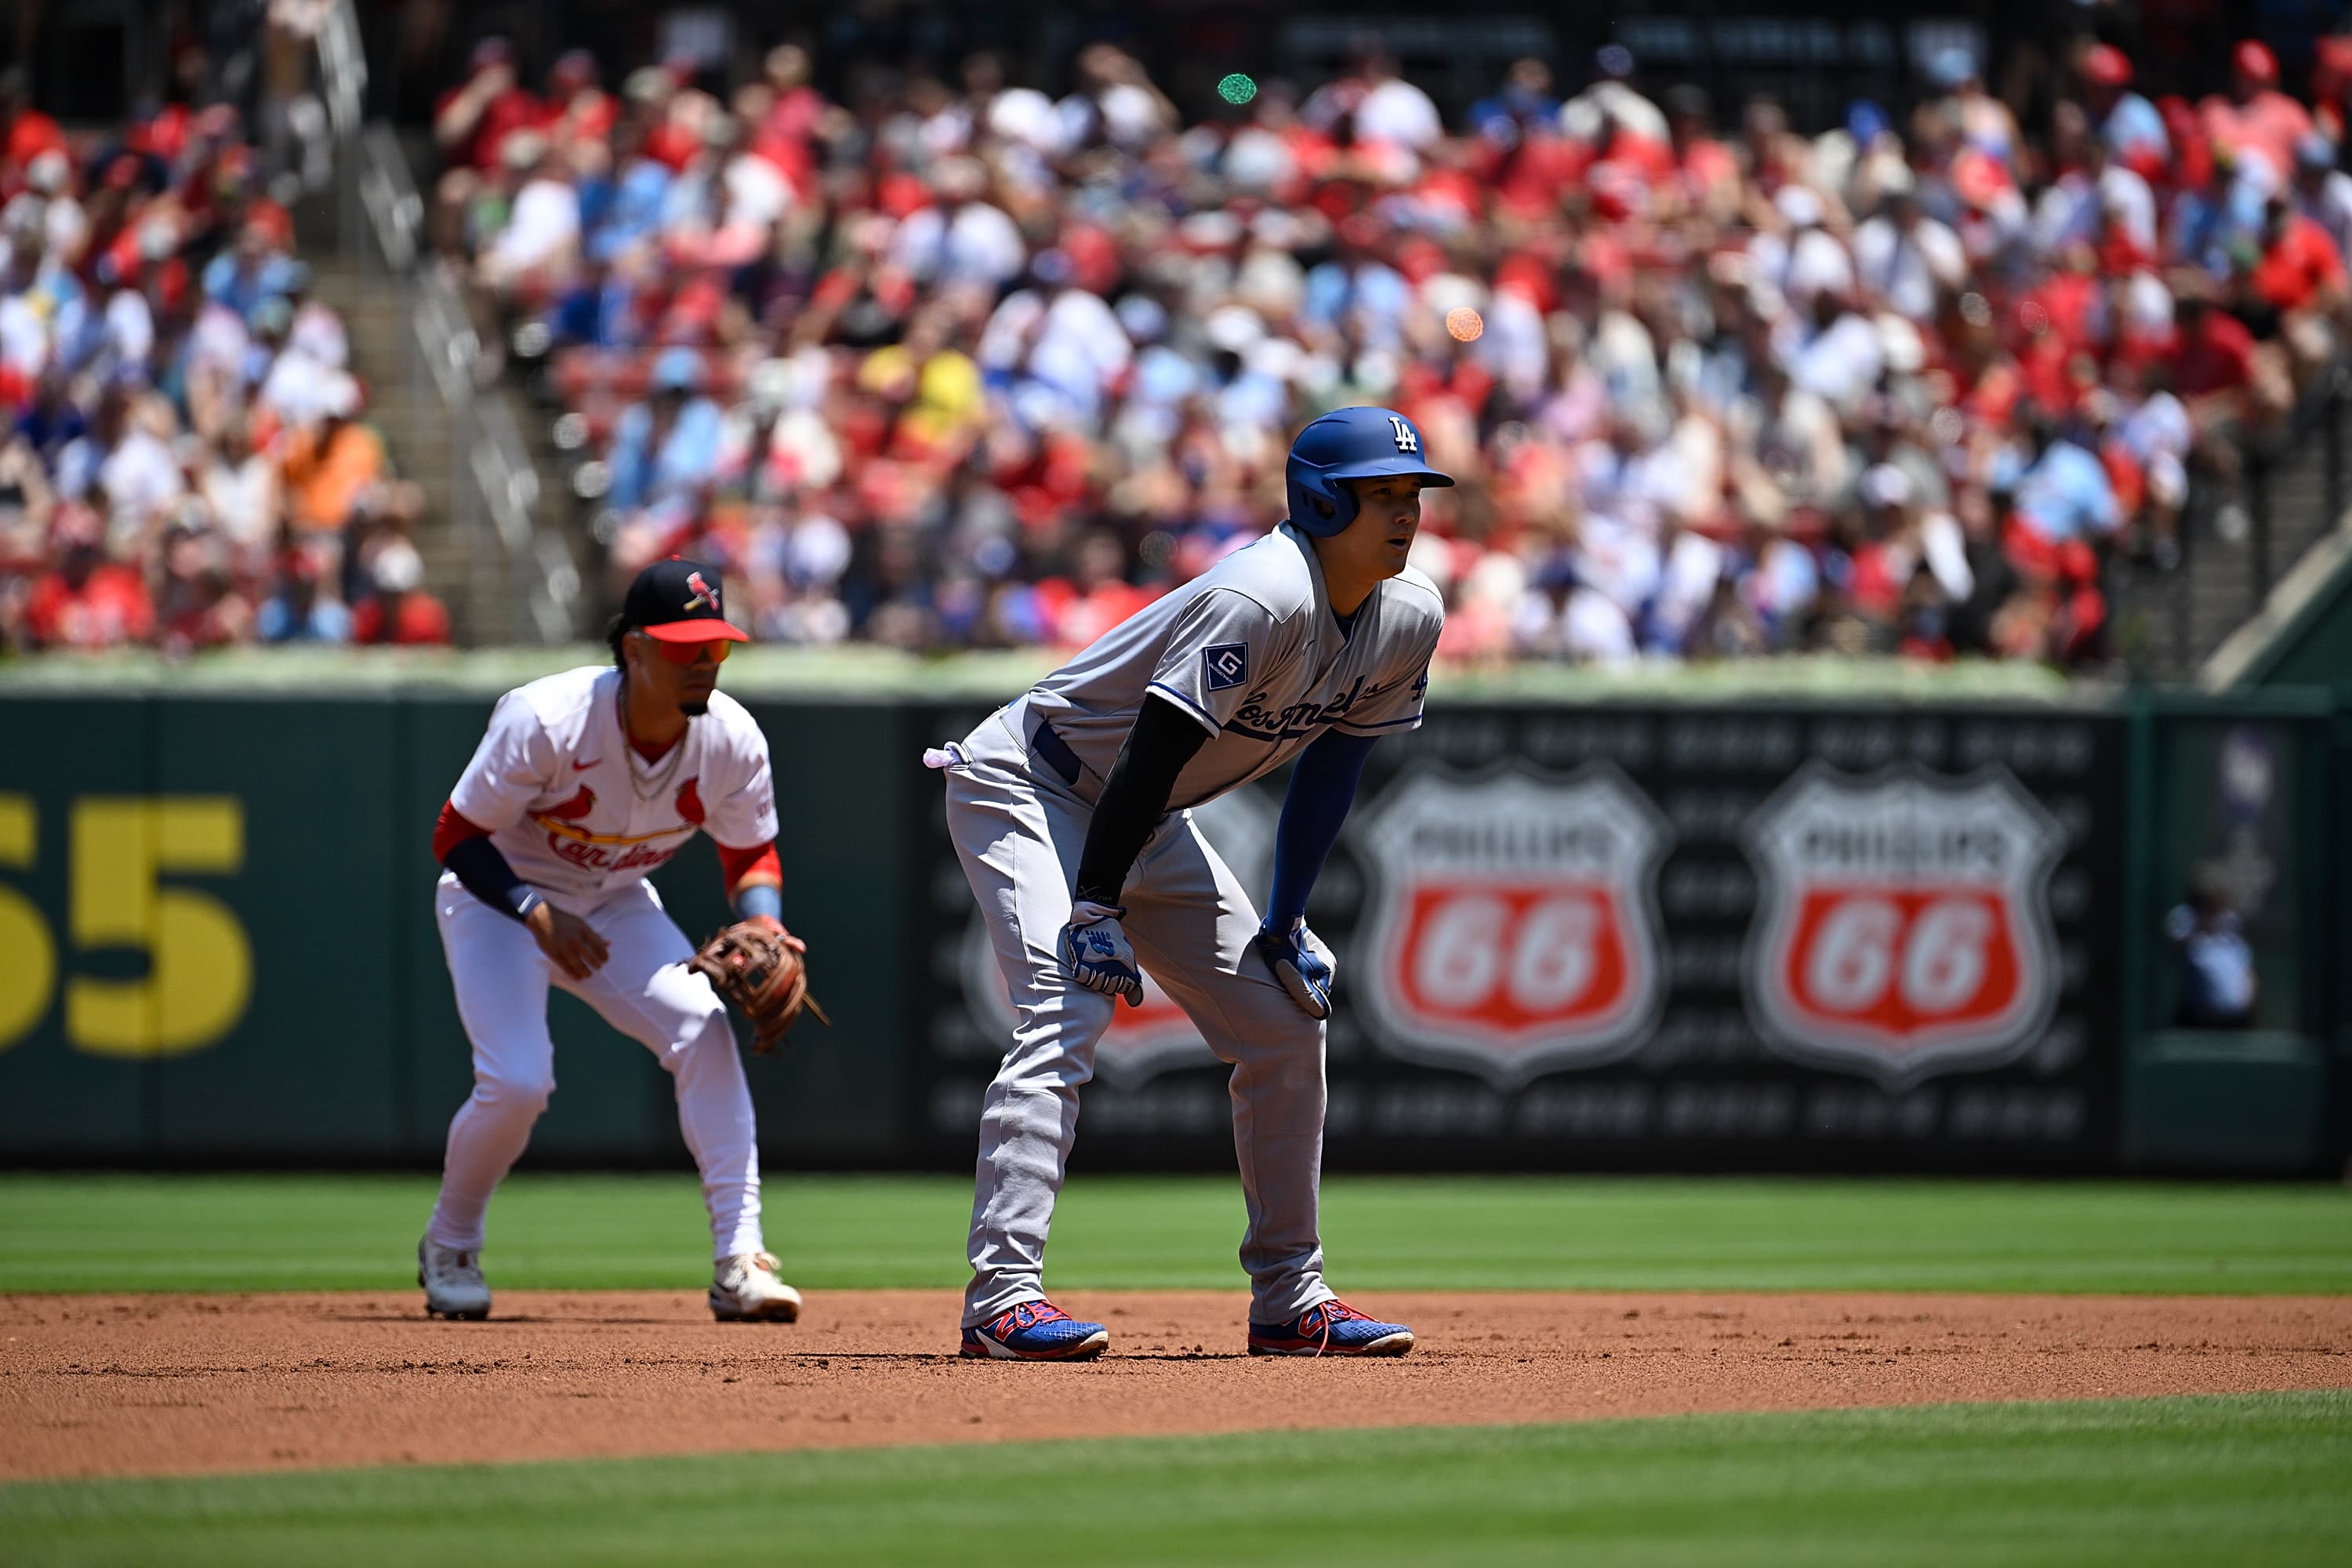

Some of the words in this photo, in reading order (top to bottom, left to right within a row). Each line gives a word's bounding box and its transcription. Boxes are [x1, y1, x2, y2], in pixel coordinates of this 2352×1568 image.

[1388, 416, 1417, 453] LA
[1415, 889, 1602, 1011] 66
[1802, 891, 1996, 1013] 66
